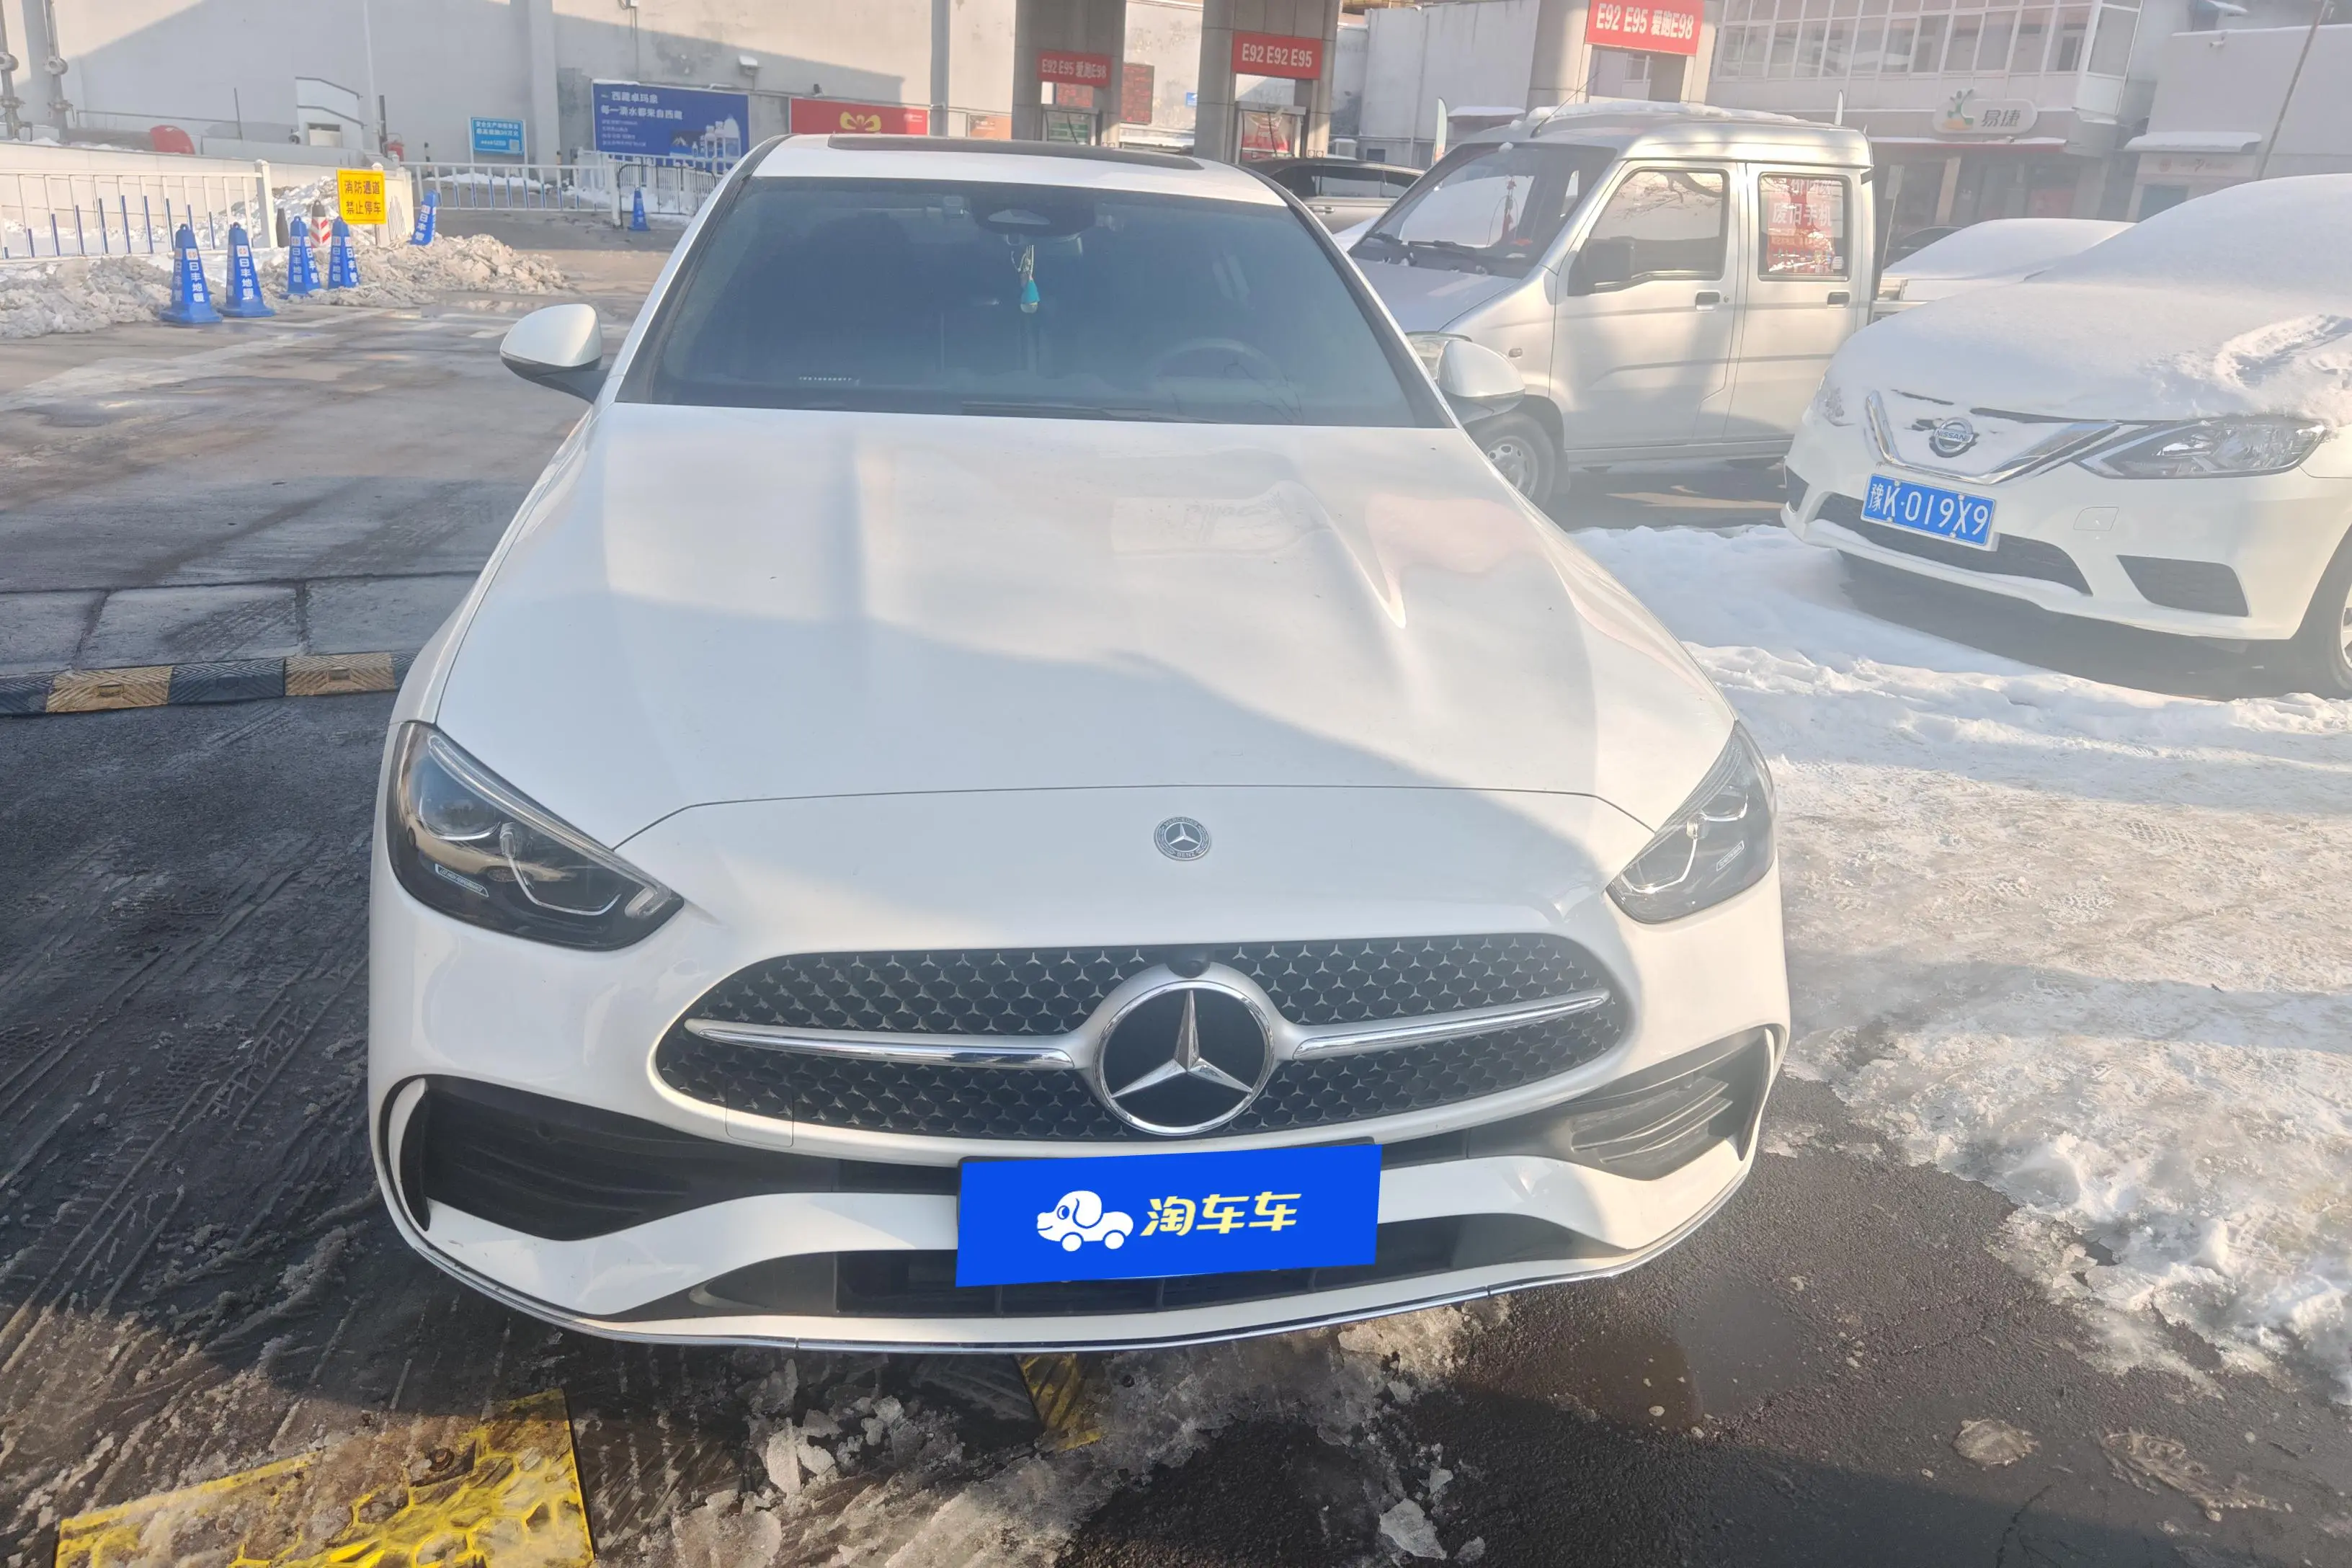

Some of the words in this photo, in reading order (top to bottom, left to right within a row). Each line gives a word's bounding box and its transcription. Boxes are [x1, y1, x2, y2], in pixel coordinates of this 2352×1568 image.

[1596, 3, 1621, 31] E92
[1623, 6, 1649, 34] E95
[1242, 43, 1264, 63] E92
[1267, 46, 1288, 66] E92
[1291, 49, 1313, 68] E95
[1042, 59, 1057, 74] E92
[1059, 61, 1075, 76] E95
[1982, 110, 2021, 127] 易捷
[345, 180, 380, 195] 消防通道
[346, 201, 381, 215] 禁止停车
[1772, 202, 1831, 227] 废旧手机
